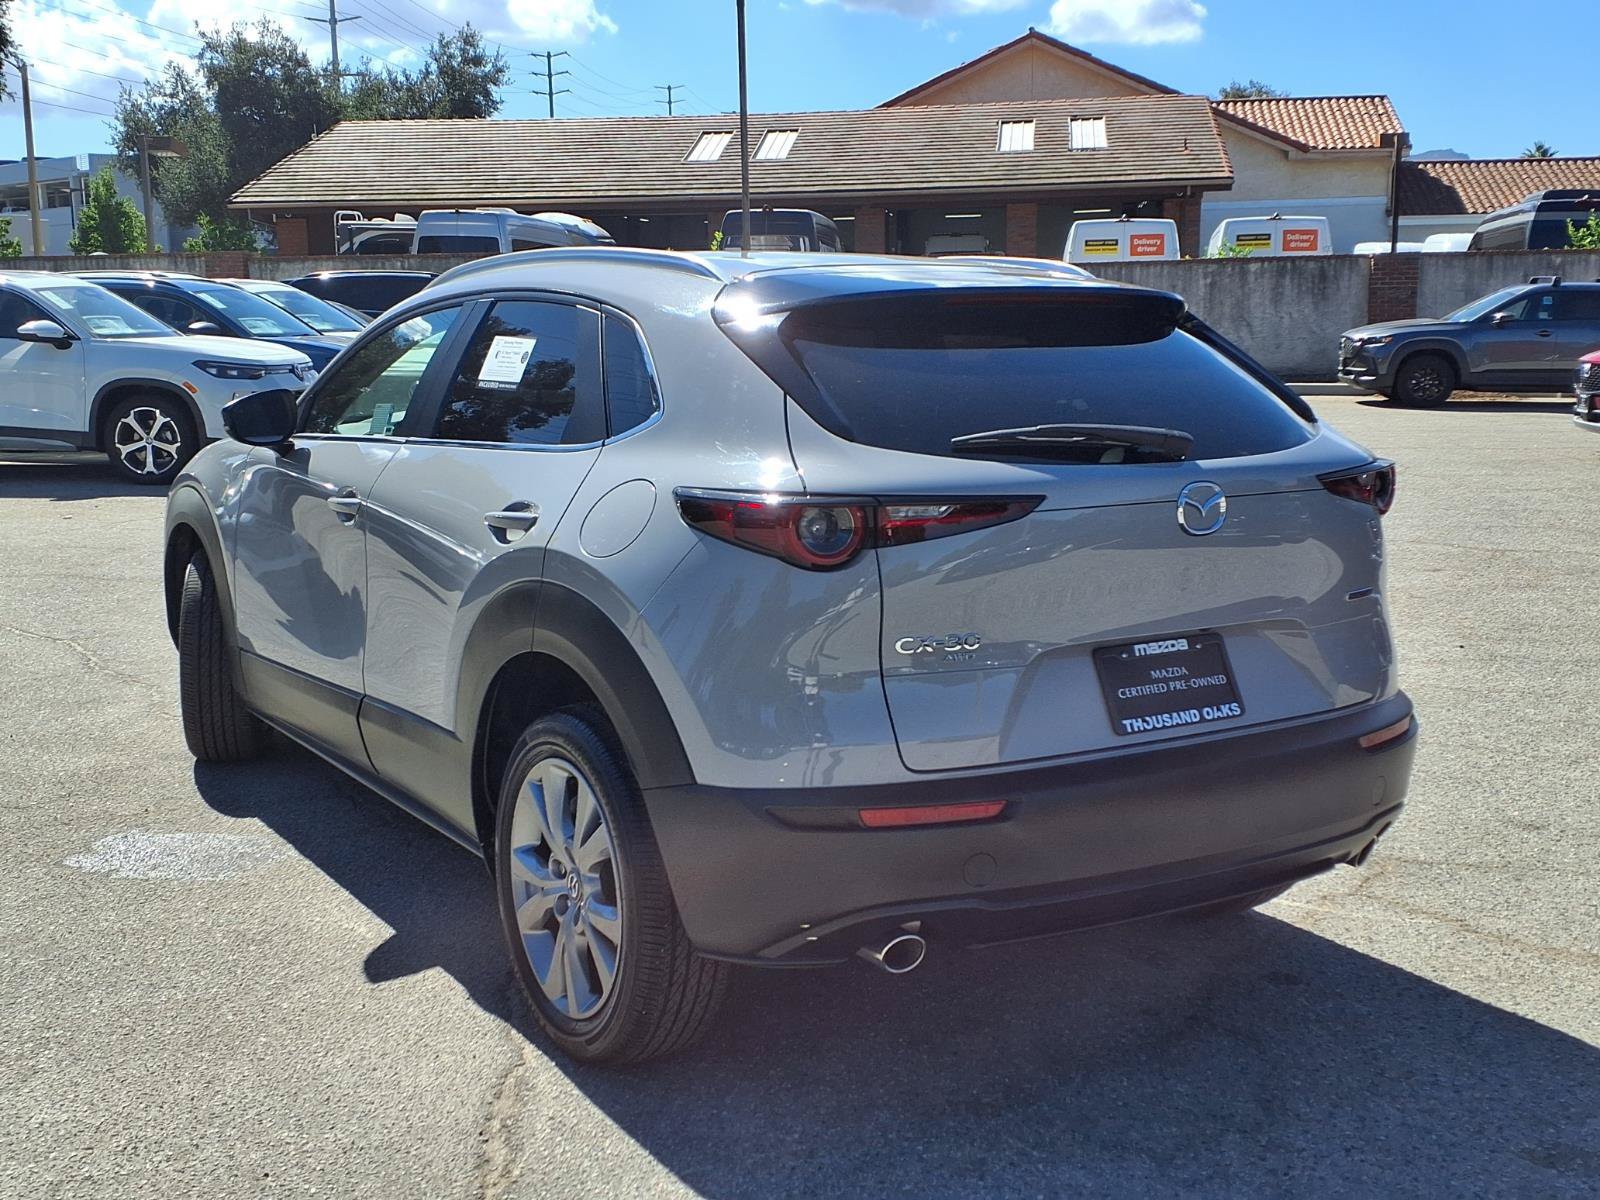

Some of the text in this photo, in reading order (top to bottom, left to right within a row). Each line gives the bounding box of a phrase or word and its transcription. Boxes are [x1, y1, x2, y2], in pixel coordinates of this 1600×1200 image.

[1133, 238, 1161, 246] Delivery
[1286, 233, 1314, 241] Delivery
[895, 632, 981, 654] CX-30
[1134, 639, 1188, 656] mazda
[1150, 666, 1189, 679] MAZDA
[1118, 674, 1227, 699] CERTIFIED PRE-OWNED
[1122, 702, 1241, 733] THOUSAND OAKS
